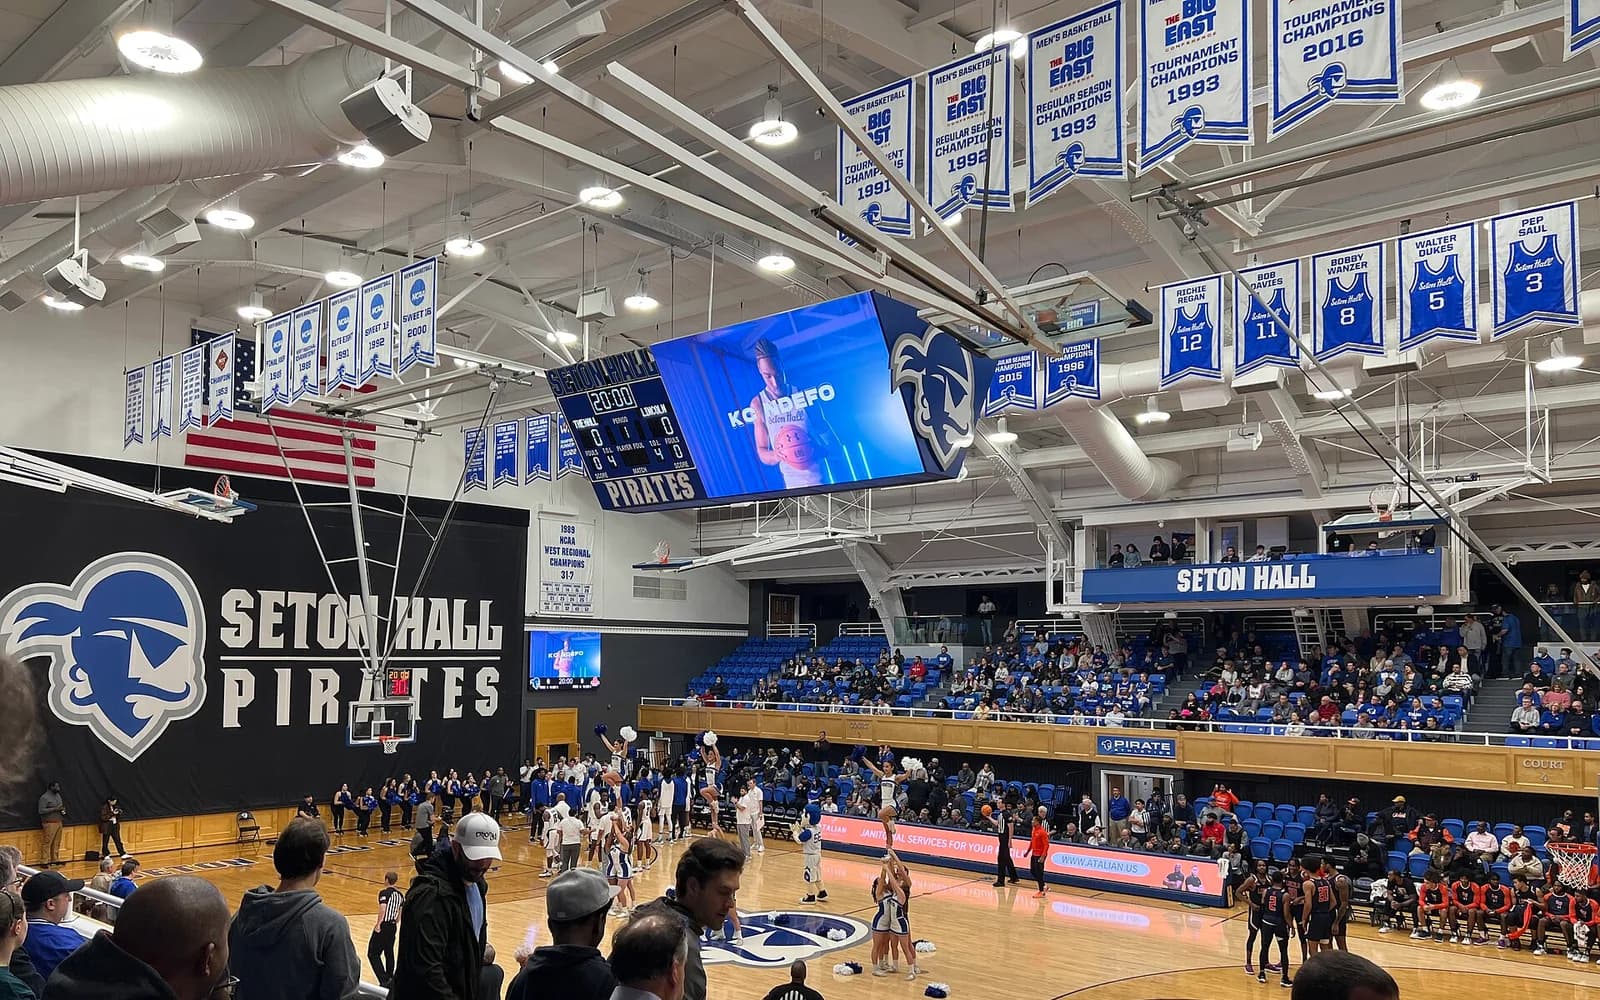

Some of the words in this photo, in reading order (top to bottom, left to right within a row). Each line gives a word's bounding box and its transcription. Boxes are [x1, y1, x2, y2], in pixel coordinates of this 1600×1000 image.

[1182, 0, 1217, 19] BIG
[1283, 0, 1374, 30] TOURNAME
[1165, 14, 1180, 26] THE
[1165, 10, 1217, 47] EAST
[1283, 2, 1385, 44] CHAMPIONS
[1036, 33, 1061, 49] MEN'S
[1062, 13, 1112, 40] BASKETBALL
[1064, 35, 1094, 62] BIG
[1303, 29, 1364, 62] 2016
[1049, 57, 1063, 68] THE
[1150, 37, 1238, 74] TOURNAMENT
[935, 71, 957, 85] MEN'S
[1049, 54, 1094, 88] EAST
[1150, 50, 1238, 88] CHAMPIONS
[960, 74, 987, 99] BIG
[1167, 74, 1220, 106] 1993
[866, 90, 905, 110] BASKETBALL
[947, 94, 959, 104] THE
[1036, 92, 1076, 114] REGULAR
[1077, 79, 1112, 100] SEASON
[947, 93, 986, 121] EAST
[1036, 90, 1112, 126] CHAMPIONS
[867, 108, 891, 131] BIG
[1051, 113, 1096, 142] 1993
[935, 126, 970, 146] REGULAR
[948, 149, 989, 173] 1992
[857, 180, 891, 200] 1991
[1519, 224, 1548, 237] SAUL
[1521, 216, 1544, 228] PEP
[1415, 234, 1457, 249] WALTER
[1418, 244, 1454, 257] DUKES
[1327, 261, 1368, 275] WANZER
[1331, 253, 1364, 267] BOBBY
[1251, 278, 1283, 290] DAVIES
[1257, 271, 1276, 281] BOB
[1526, 273, 1543, 292] 3
[1176, 285, 1207, 296] RICHIE
[1178, 293, 1206, 304] REGAN
[1429, 291, 1445, 310] 5
[402, 310, 424, 323] SWEET
[424, 308, 432, 317] 16
[1340, 308, 1355, 325] 8
[365, 324, 382, 337] SWEET
[407, 325, 427, 338] 2000
[1256, 321, 1277, 340] 11
[369, 338, 385, 350] 1992
[1062, 343, 1091, 353] IVISION
[1180, 334, 1202, 352] 12
[336, 349, 350, 360] 1991
[995, 361, 1031, 372] HAMPIONS
[1058, 361, 1084, 373] 1996
[998, 372, 1022, 383] 2015
[591, 386, 633, 412] 20:00
[590, 428, 603, 447] 0
[661, 416, 674, 435] 0
[593, 457, 603, 470] 0
[673, 444, 684, 459] 0
[602, 471, 696, 508] PIRATES
[545, 546, 561, 556] WEST
[561, 547, 591, 558] REGIONAL
[549, 558, 585, 568] CHAMPIONS
[1176, 565, 1245, 593] SETON
[1253, 563, 1316, 590] HALL
[220, 588, 378, 650] SETON
[394, 595, 503, 650] HALL
[220, 666, 500, 728] PIRATES
[1114, 740, 1171, 751] PIRATE
[1523, 758, 1566, 769] COURT
[907, 834, 948, 849] SERVICES
[948, 839, 967, 850] FOR
[968, 842, 993, 854] YOUR
[1061, 855, 1138, 874] WWW.ATALIAN.US
